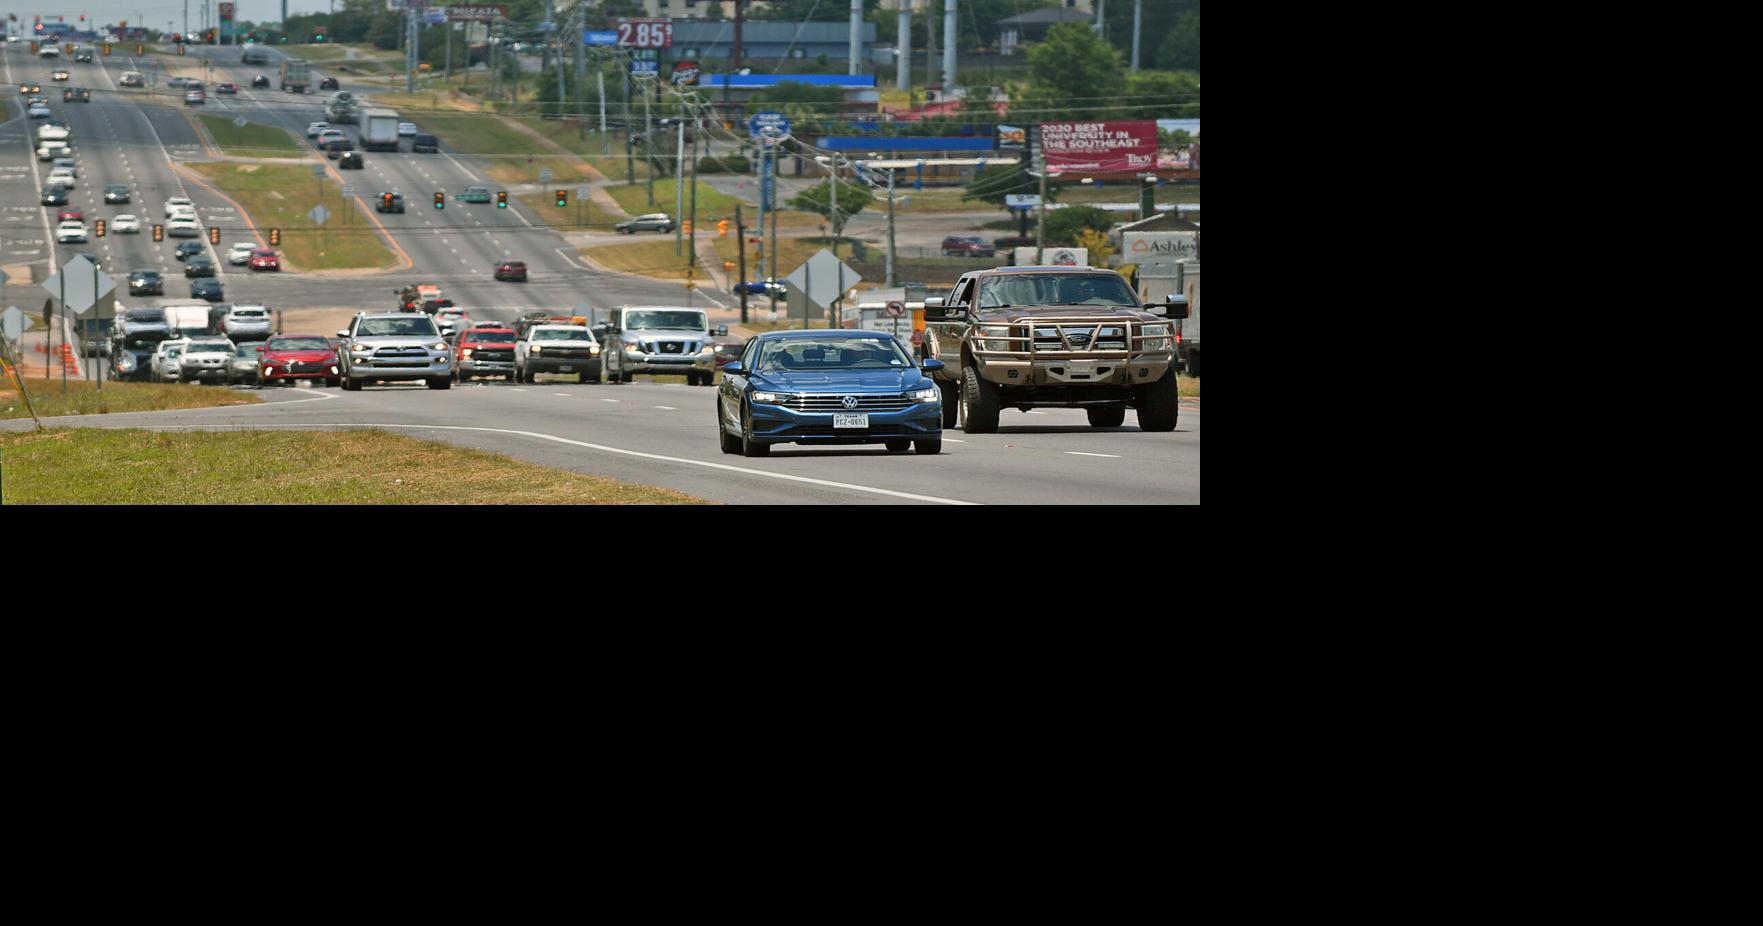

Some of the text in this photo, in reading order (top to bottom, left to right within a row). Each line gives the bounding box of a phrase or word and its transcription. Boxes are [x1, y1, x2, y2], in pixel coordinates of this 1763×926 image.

[1041, 123, 1105, 132] 2020 BEST
[1042, 130, 1129, 140] UNIVERSITY IN
[1042, 138, 1140, 149] THE SOUTHEAST
[1152, 240, 1197, 252] Ashley
